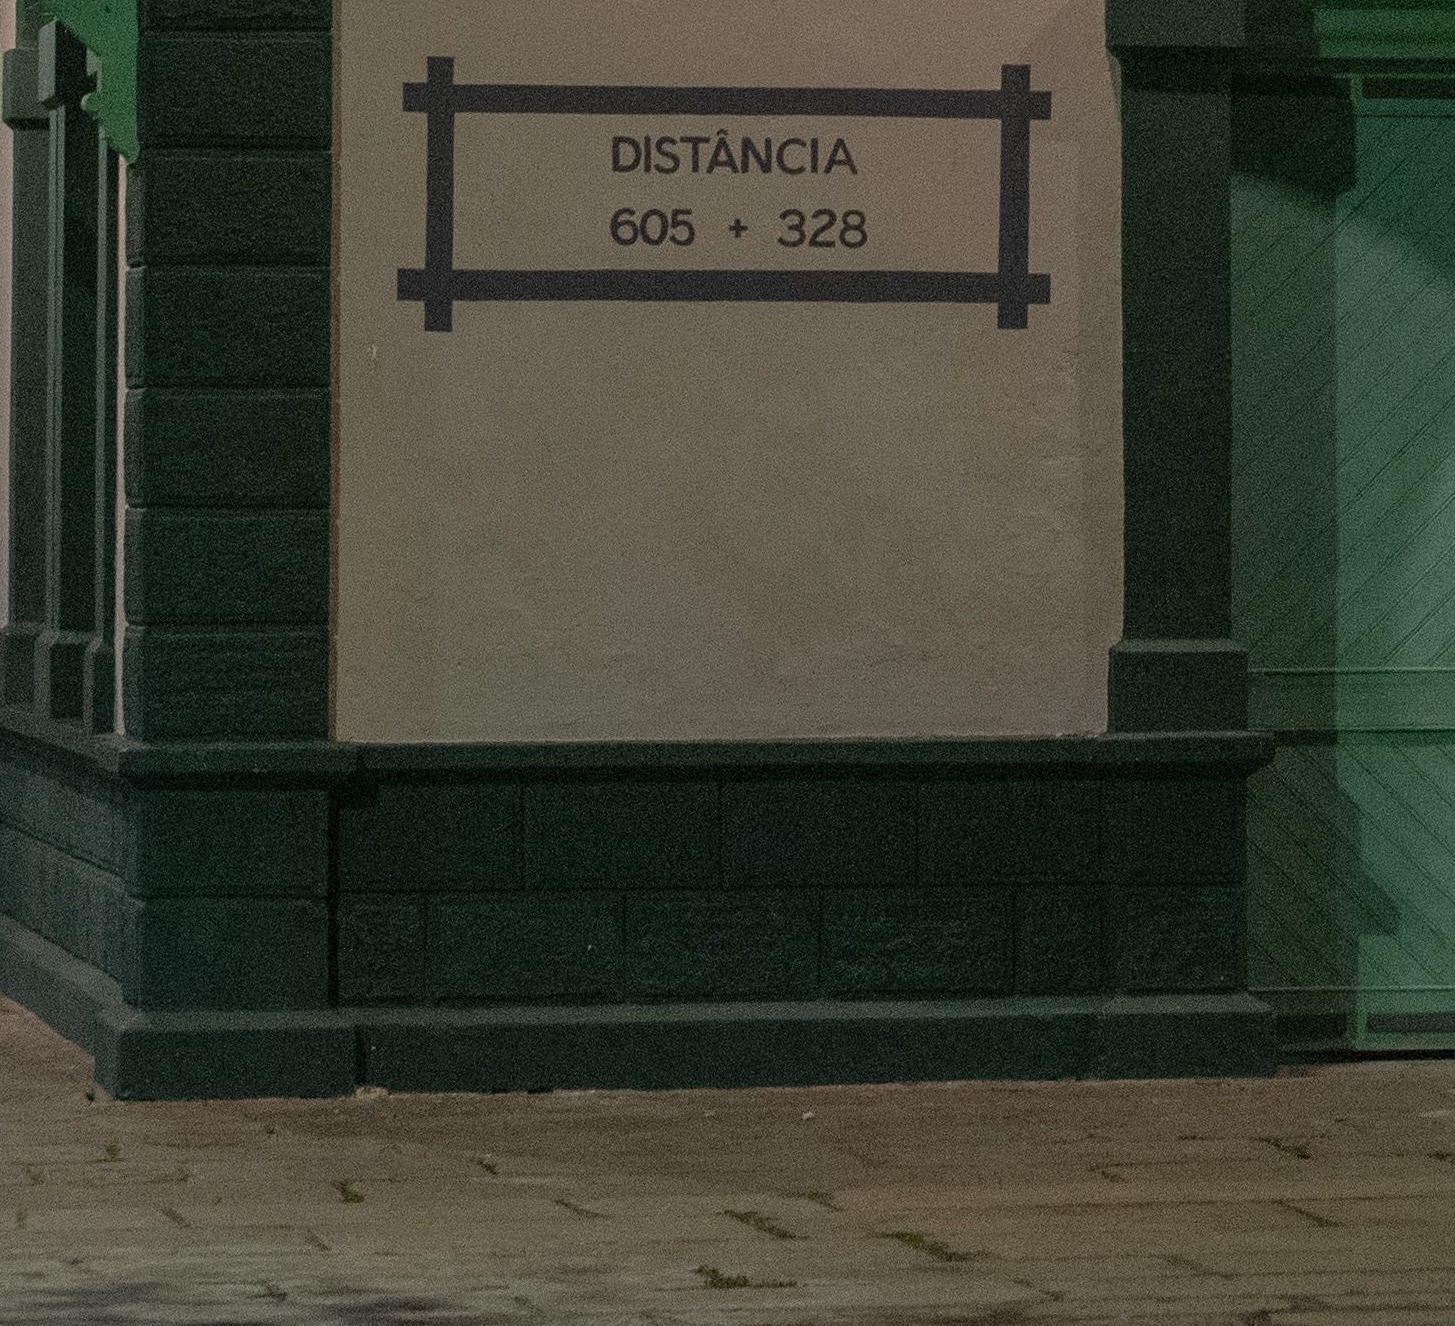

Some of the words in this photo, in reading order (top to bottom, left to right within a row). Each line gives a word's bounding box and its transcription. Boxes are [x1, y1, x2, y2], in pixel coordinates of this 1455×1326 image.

[611, 129, 858, 176] DISTÂNCIA
[609, 207, 696, 247] 605
[778, 207, 868, 250] 328
